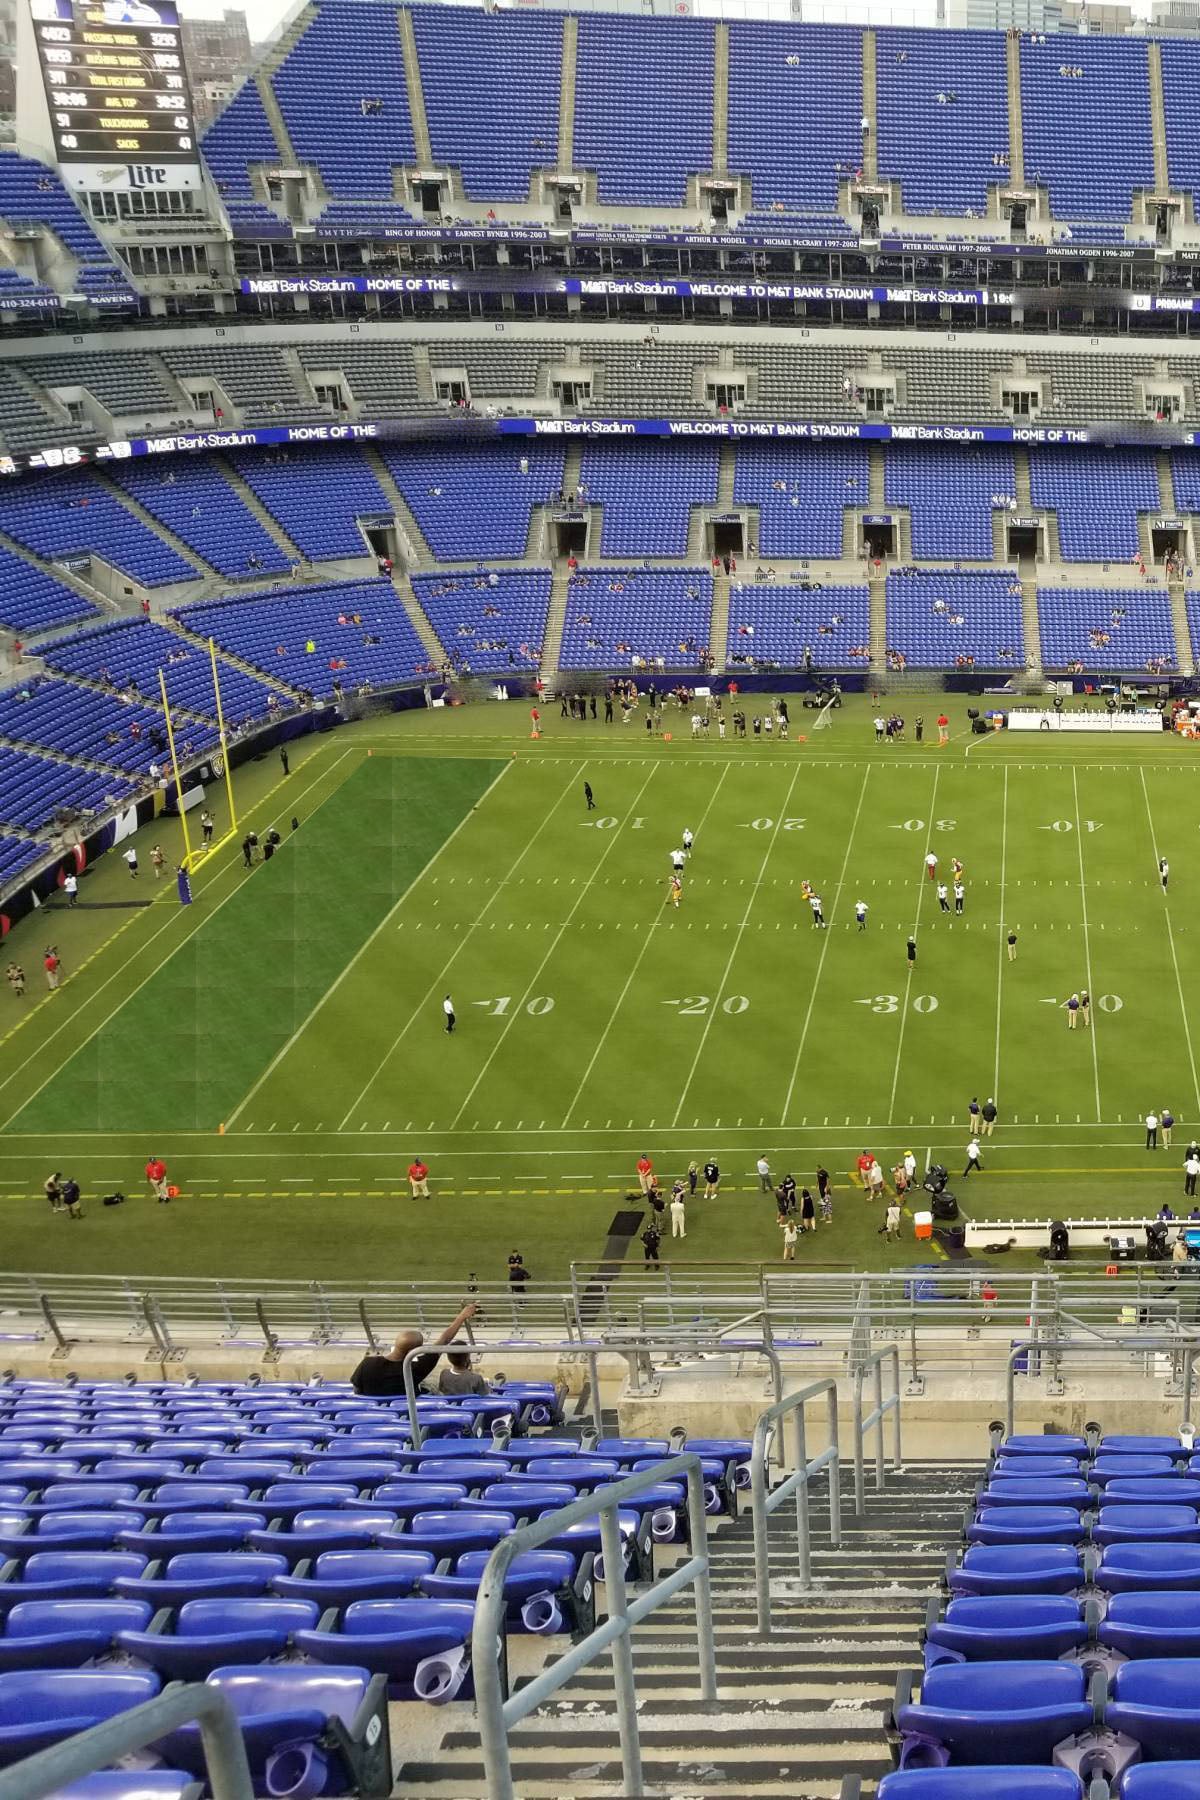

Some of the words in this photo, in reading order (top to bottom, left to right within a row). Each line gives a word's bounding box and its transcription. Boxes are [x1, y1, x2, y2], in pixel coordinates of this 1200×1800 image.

[125, 165, 166, 188] Lite
[385, 229, 400, 237] RING
[415, 230, 442, 238] HONOR
[455, 230, 485, 238] EARNEST
[510, 231, 547, 239] 1996-2003
[685, 236, 709, 244] ARTHUR
[720, 237, 746, 245] MODELL
[764, 238, 792, 246] MICHAEL
[793, 239, 822, 247] McCRARY
[824, 240, 858, 248] 1997-2002
[280, 280, 308, 292] Bank
[310, 280, 355, 292] Stadium
[366, 280, 403, 291] HOME
[406, 280, 423, 290] OF
[425, 279, 450, 290] THE
[608, 282, 633, 293] Bank
[634, 282, 676, 294] Stadium
[690, 284, 747, 296] WELCOME
[750, 285, 765, 296] TO
[767, 286, 791, 297] M&T
[794, 288, 822, 298] BANK
[825, 288, 873, 299] STADIUM
[913, 290, 937, 301] Bank
[938, 290, 977, 304] Stadium
[91, 296, 134, 304] RAVENS
[289, 428, 328, 440] HOME
[330, 426, 349, 438] OF
[351, 425, 376, 436] THE
[564, 421, 590, 432] Bank
[591, 422, 635, 433] Stadium
[670, 423, 728, 434] WELCOME
[731, 423, 748, 434] TO
[750, 424, 774, 435] M&T
[777, 425, 807, 436] BANK
[810, 425, 859, 436] STADIUM
[918, 428, 943, 439] Bank
[944, 428, 984, 440] Stadium
[1013, 430, 1045, 440] HOME
[1047, 431, 1063, 441] OF
[1066, 431, 1086, 442] THE
[148, 439, 178, 452] M&T
[178, 437, 206, 450] Bank
[207, 433, 256, 447] Stadium
[485, 996, 555, 1015] 10
[678, 996, 750, 1014] 20
[871, 995, 939, 1013] 30
